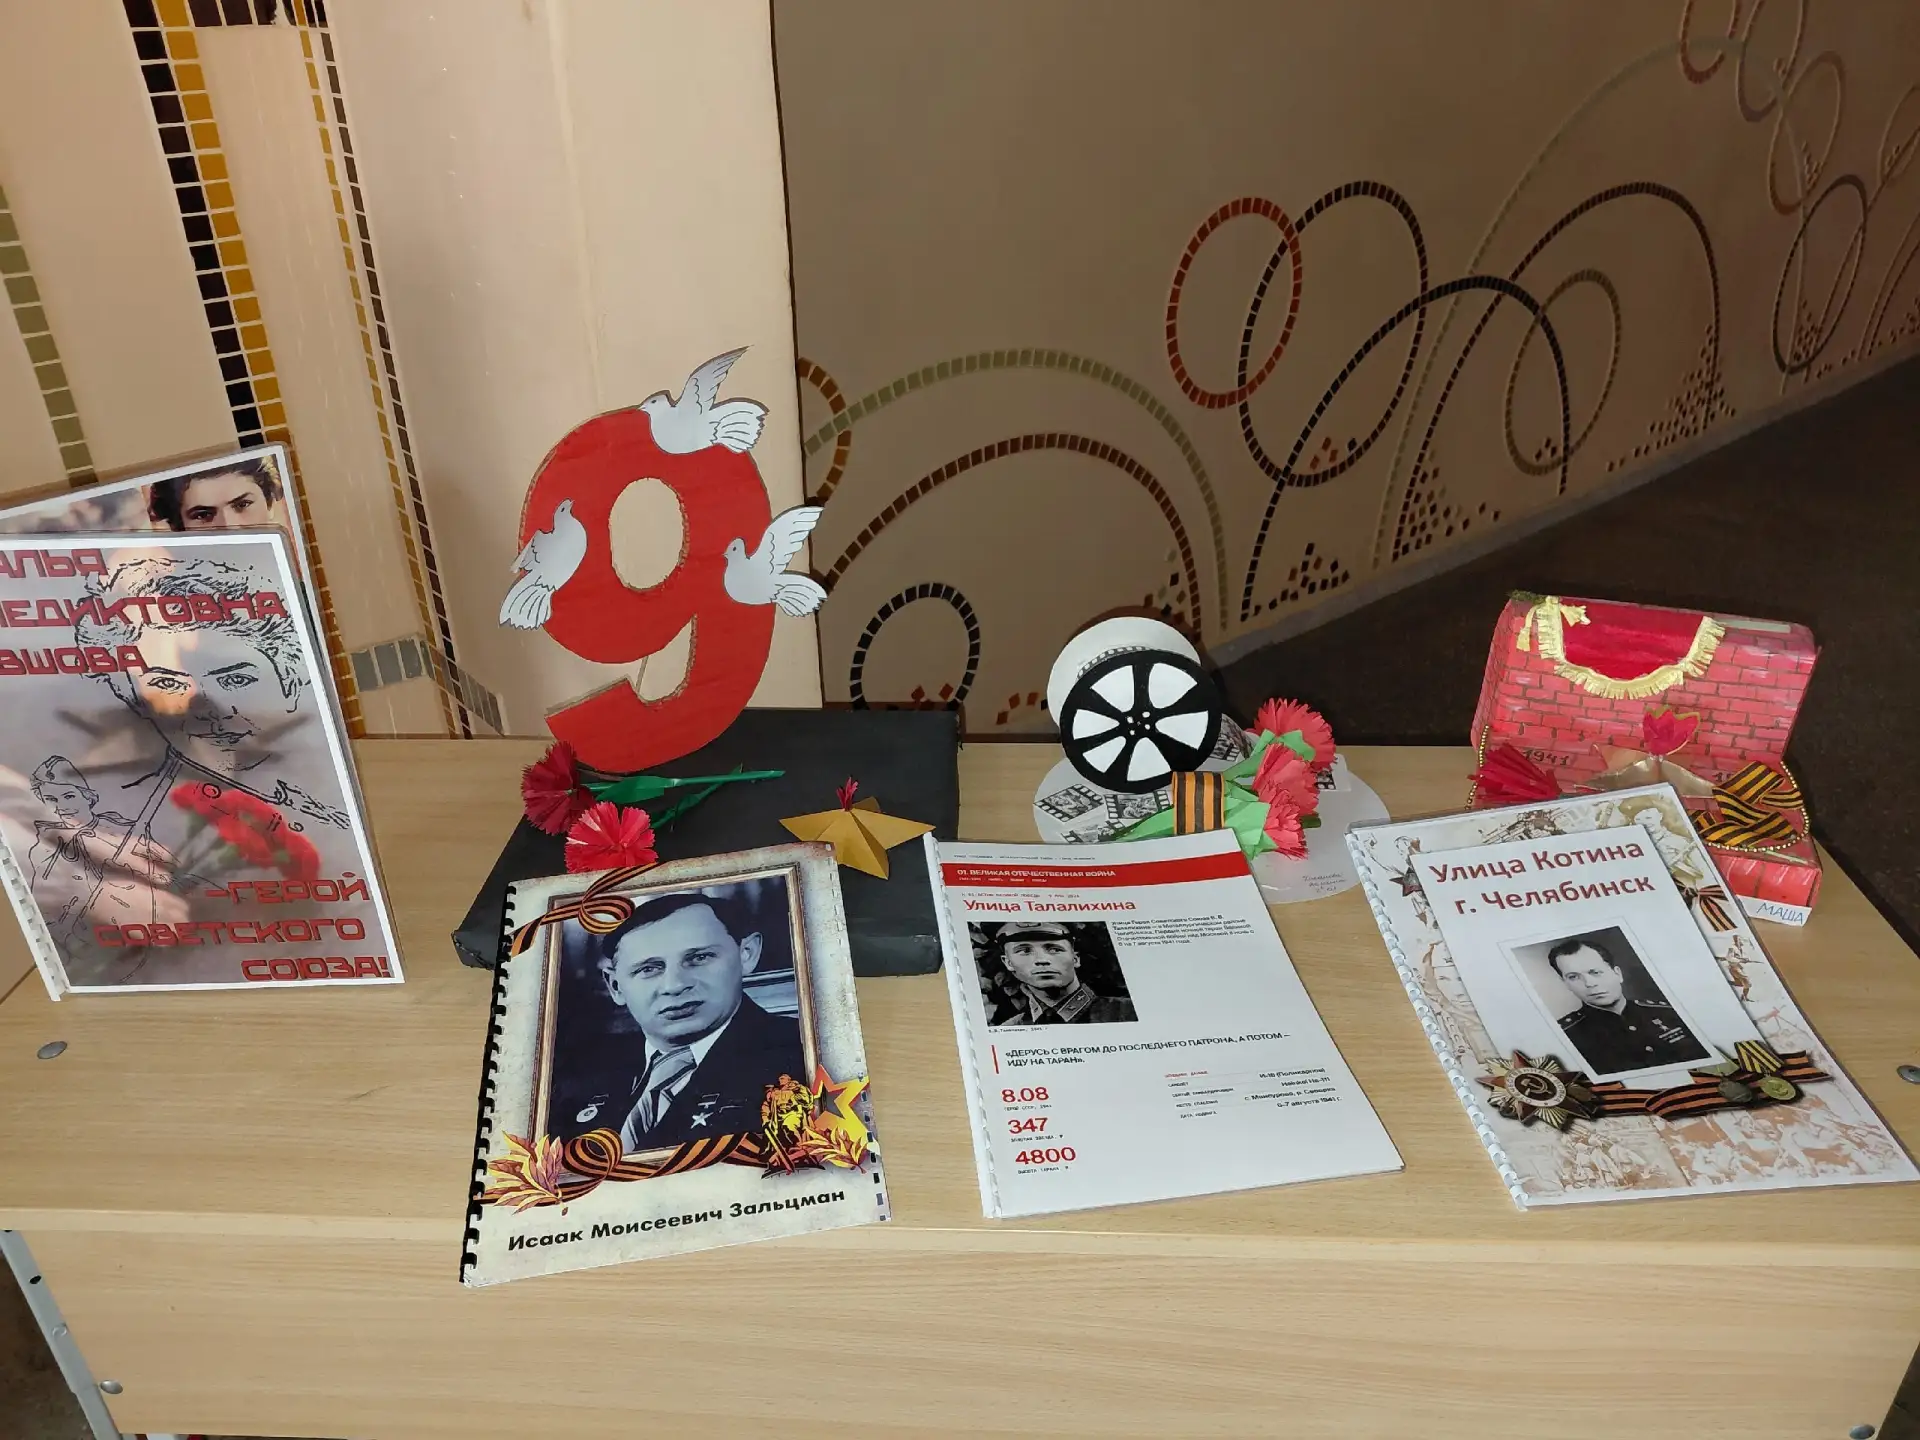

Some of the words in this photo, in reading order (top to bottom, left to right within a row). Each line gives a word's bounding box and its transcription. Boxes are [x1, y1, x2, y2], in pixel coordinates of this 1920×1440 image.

[0, 591, 288, 627] ЕДИКТОВНА
[1522, 749, 1571, 766] 1941
[1085, 869, 1116, 877] ВОЙНА
[1428, 858, 1526, 884] Улица
[1531, 842, 1645, 870] Котина
[963, 900, 1021, 913] Улица
[1024, 900, 1136, 912] Талалихина
[1454, 899, 1477, 914] г.
[1481, 877, 1656, 910] Челябинск
[1756, 902, 1804, 925] МАША
[93, 918, 366, 946] СОВЕТСКОГО
[241, 957, 392, 981] СОЮЗА!
[1005, 1049, 1050, 1058] «ДЕРУСЬ
[1060, 1046, 1100, 1054] ВРАГОМ
[1102, 1045, 1117, 1053] ДО
[1119, 1041, 1187, 1051] ПОСЛЕДНЕГО
[1188, 1036, 1238, 1047] ПАТРОНА,
[1246, 1032, 1283, 1041] ПОТОМ
[1007, 1058, 1028, 1067] ИДУ
[1030, 1057, 1045, 1066] НА
[1046, 1055, 1085, 1064] ТАРАН».
[1002, 1087, 1049, 1102] 8.08
[1007, 1117, 1048, 1134] 347
[1015, 1147, 1076, 1165] 4800
[508, 1229, 584, 1251] Исаак
[591, 1209, 723, 1239] Моисеевич
[729, 1189, 846, 1218] Зальцман
